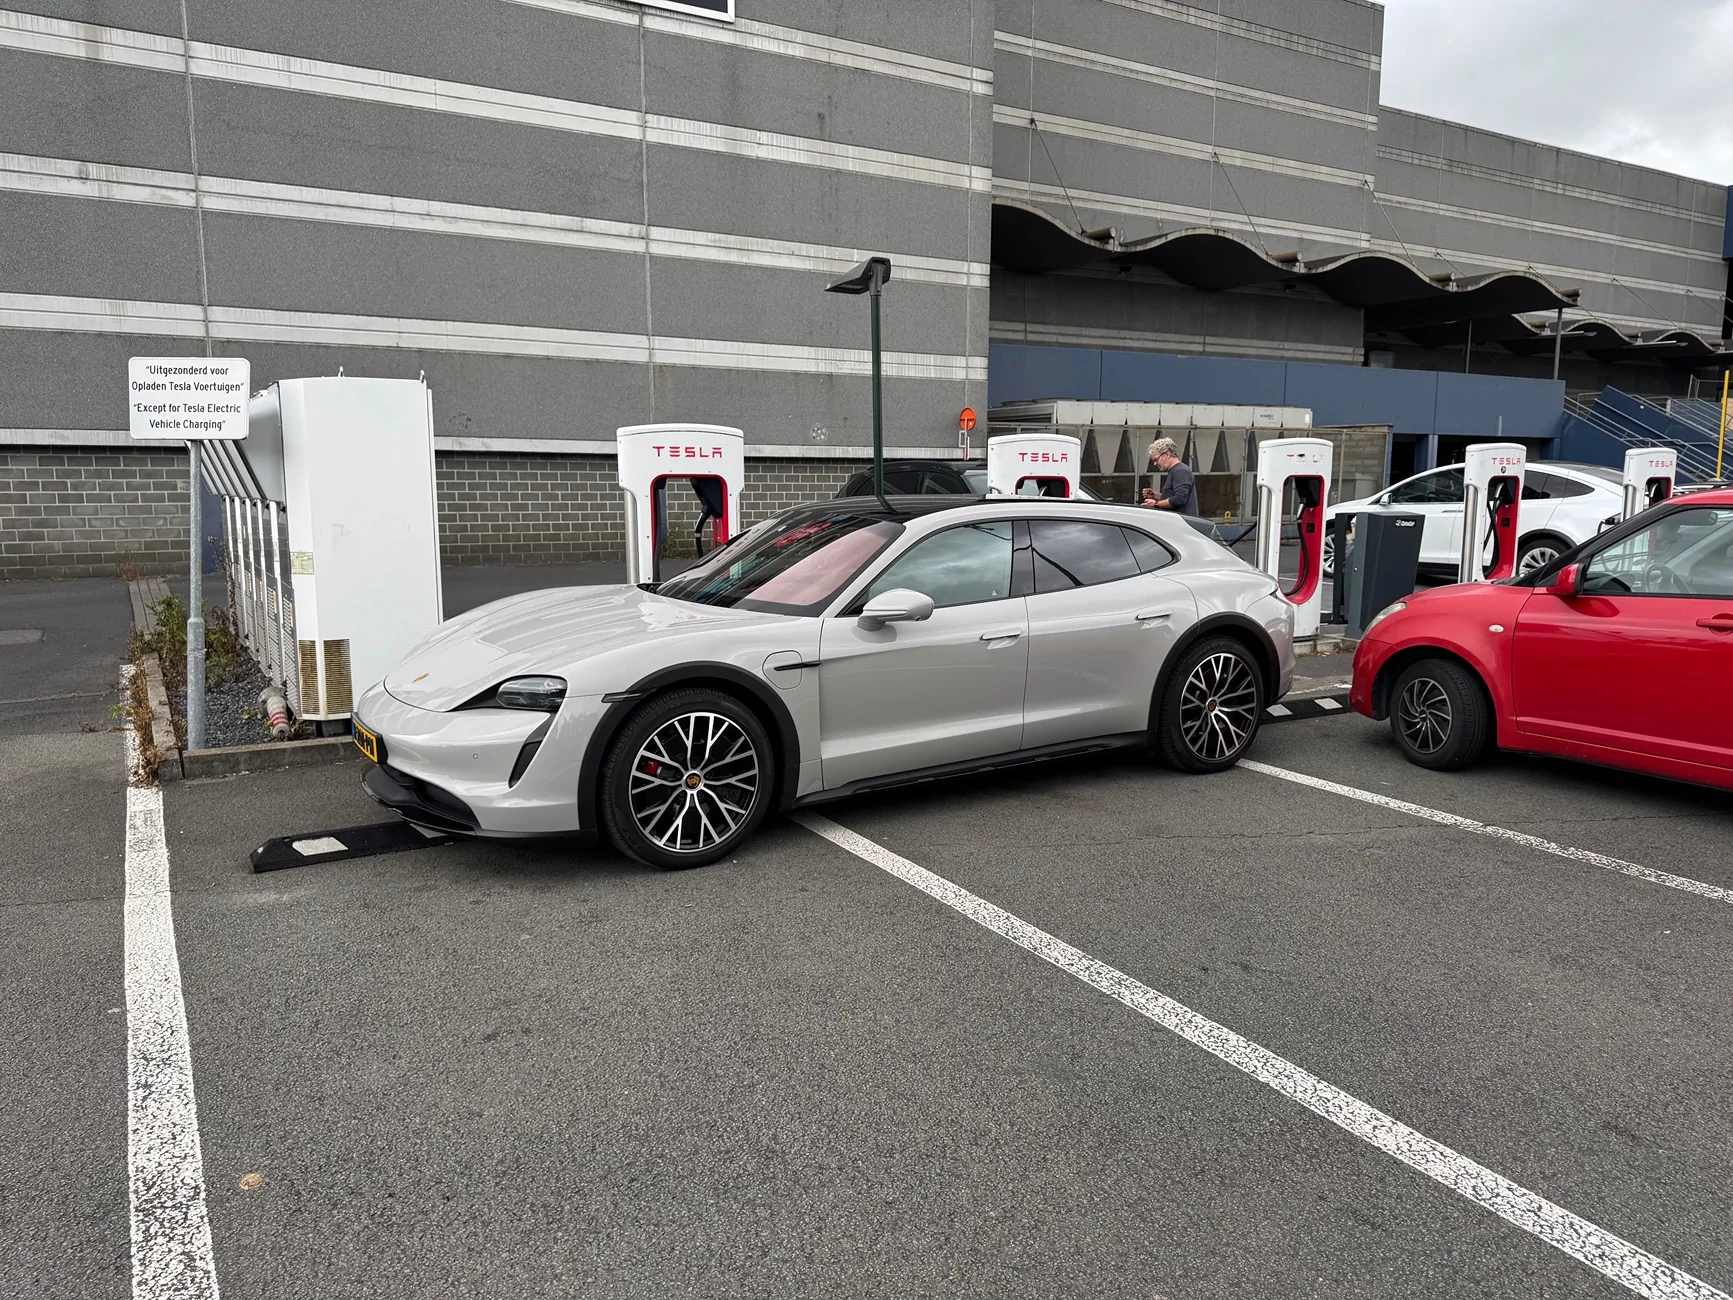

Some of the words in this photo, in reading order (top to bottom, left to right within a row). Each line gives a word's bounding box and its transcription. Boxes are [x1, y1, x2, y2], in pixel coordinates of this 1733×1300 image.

[131, 381, 167, 392] Opladen
[169, 381, 191, 391] Tesla
[168, 403, 181, 412] for
[183, 403, 205, 413] Tesla
[207, 403, 241, 413] Electric
[149, 419, 181, 428] Vehicle
[652, 446, 722, 458] TESLA
[1018, 452, 1068, 463] TESLA
[1491, 457, 1521, 465] TESLA
[1648, 460, 1673, 468] TESLA
